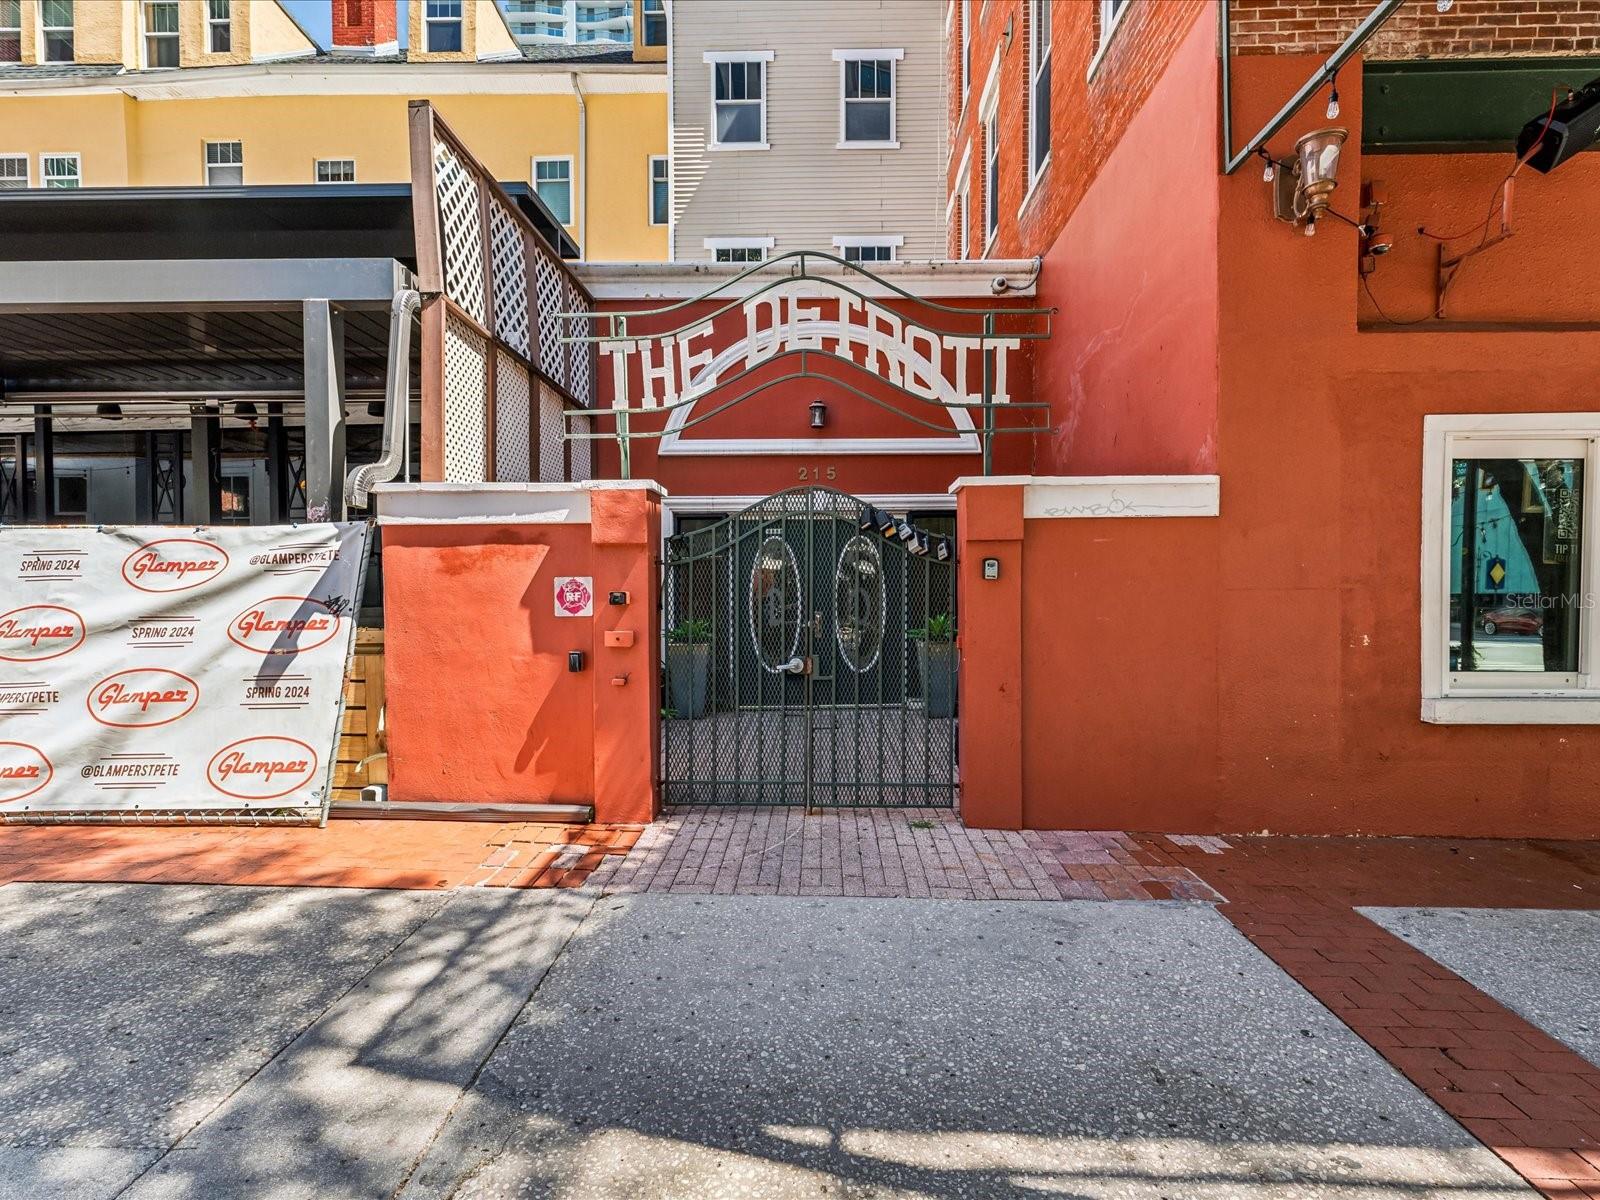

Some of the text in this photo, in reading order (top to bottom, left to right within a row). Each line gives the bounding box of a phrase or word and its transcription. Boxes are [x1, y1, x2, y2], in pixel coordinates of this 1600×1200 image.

[599, 282, 1021, 411] THE DETROIT
[798, 466, 837, 481] 215
[1555, 544, 1569, 554] TIP
[20, 559, 81, 572] SPRING 2024
[132, 552, 220, 580] Glamper
[131, 625, 195, 639] SPRING 2024
[237, 610, 329, 640] Glamper
[98, 682, 189, 711] Glamper
[246, 685, 310, 699] SPRING 2024
[81, 763, 181, 779] @GLAMPERSTPETE
[218, 751, 308, 783] Glamper
